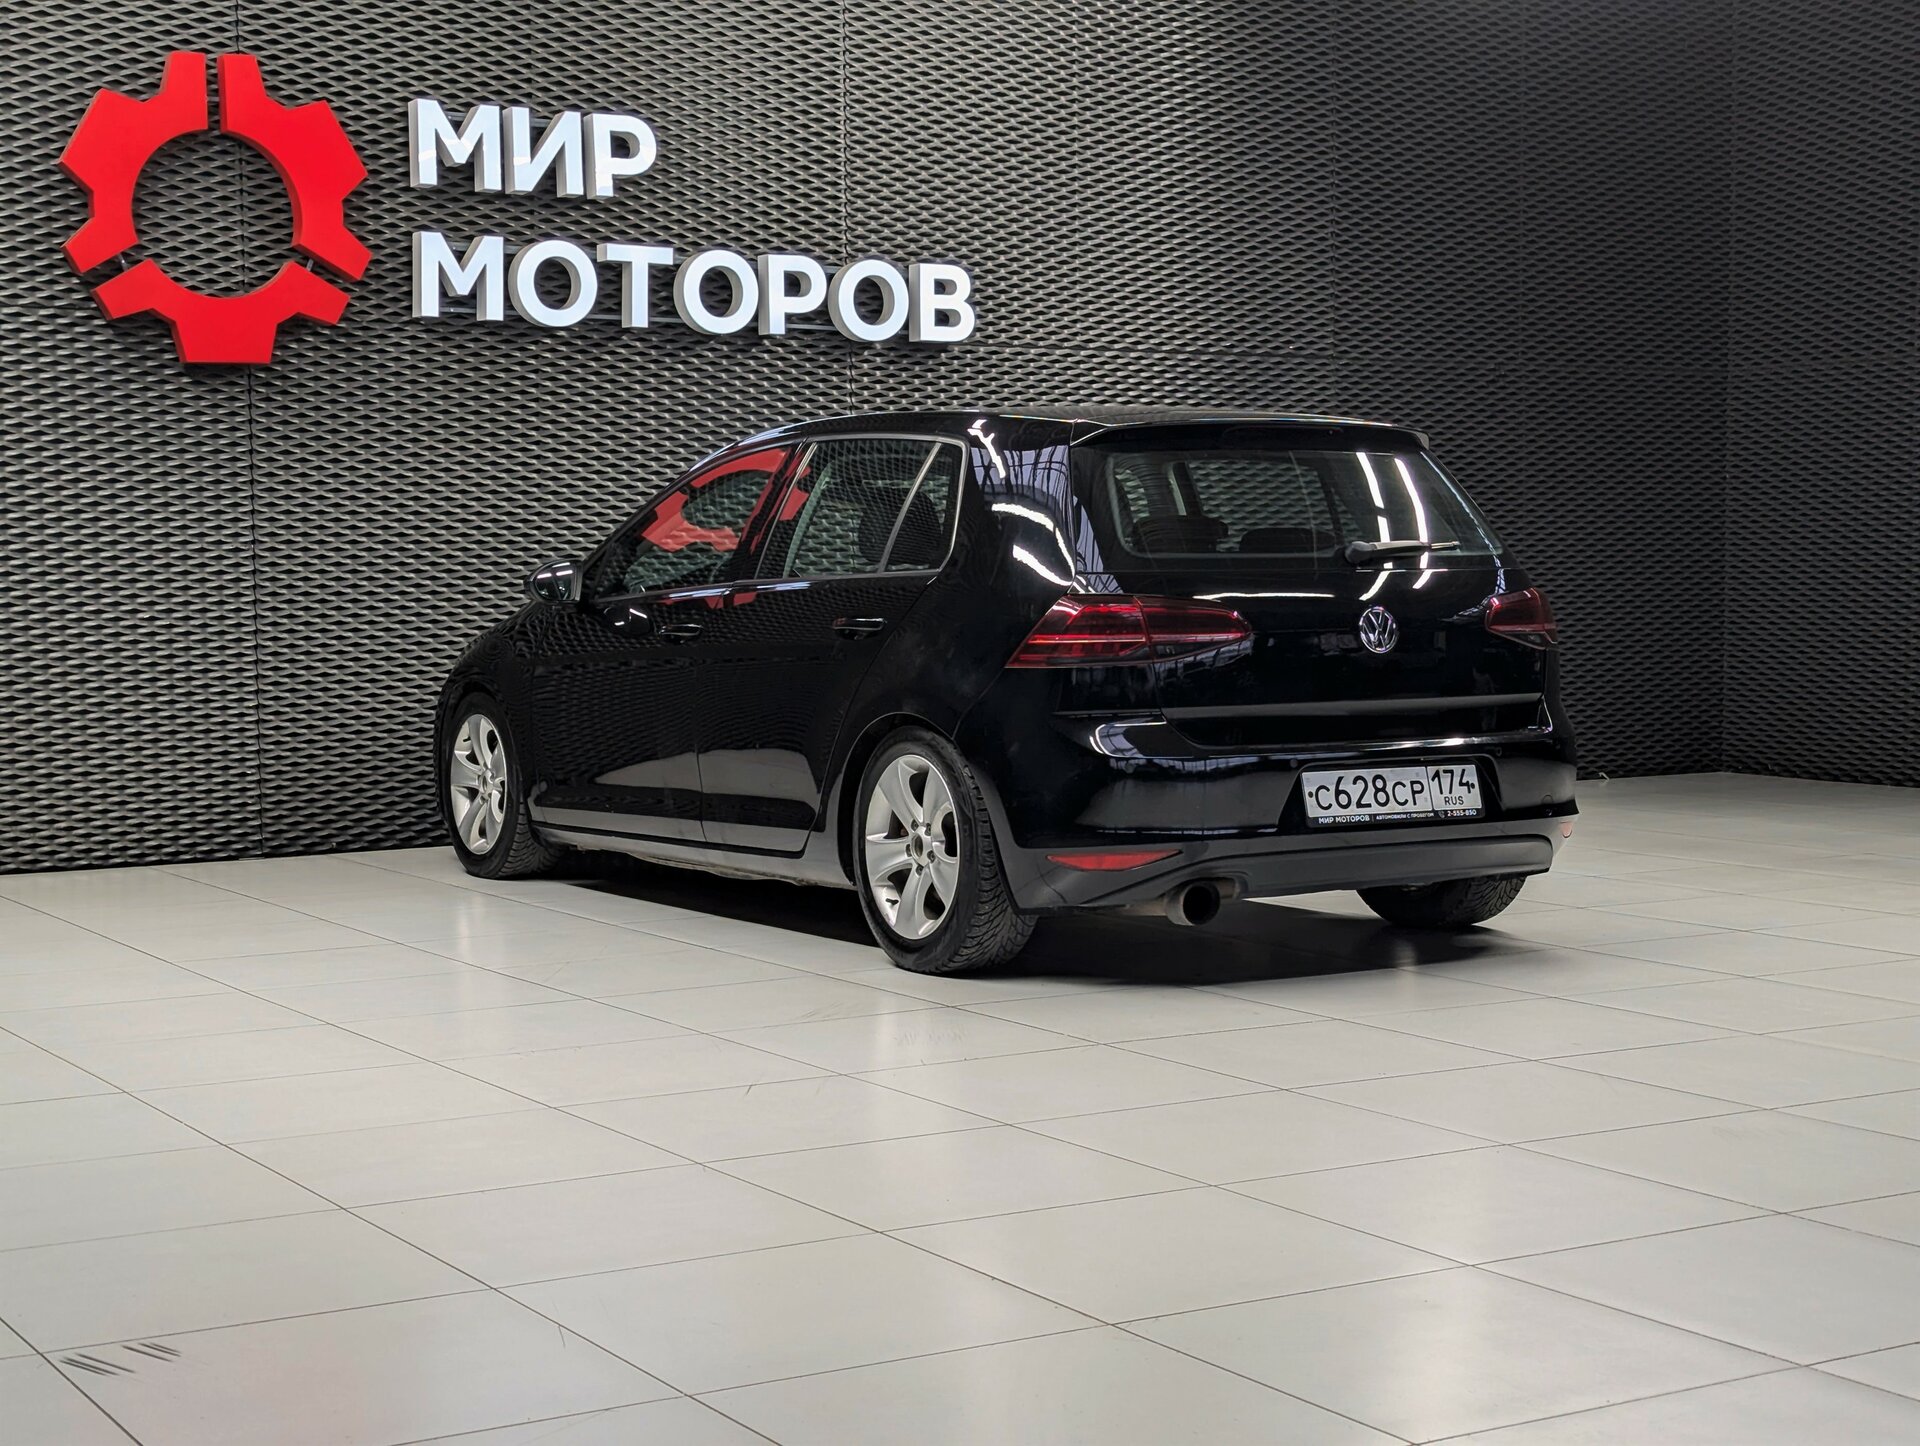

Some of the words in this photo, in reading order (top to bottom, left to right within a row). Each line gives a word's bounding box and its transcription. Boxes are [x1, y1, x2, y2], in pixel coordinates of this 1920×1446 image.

[408, 98, 658, 200] МИР
[411, 231, 976, 342] МОТОРОВ
[1314, 774, 1425, 811] С628СР
[1431, 768, 1472, 795] 174
[1444, 796, 1464, 806] RUS
[1318, 816, 1334, 824] МИР
[1335, 814, 1370, 823] МОТОРОВ
